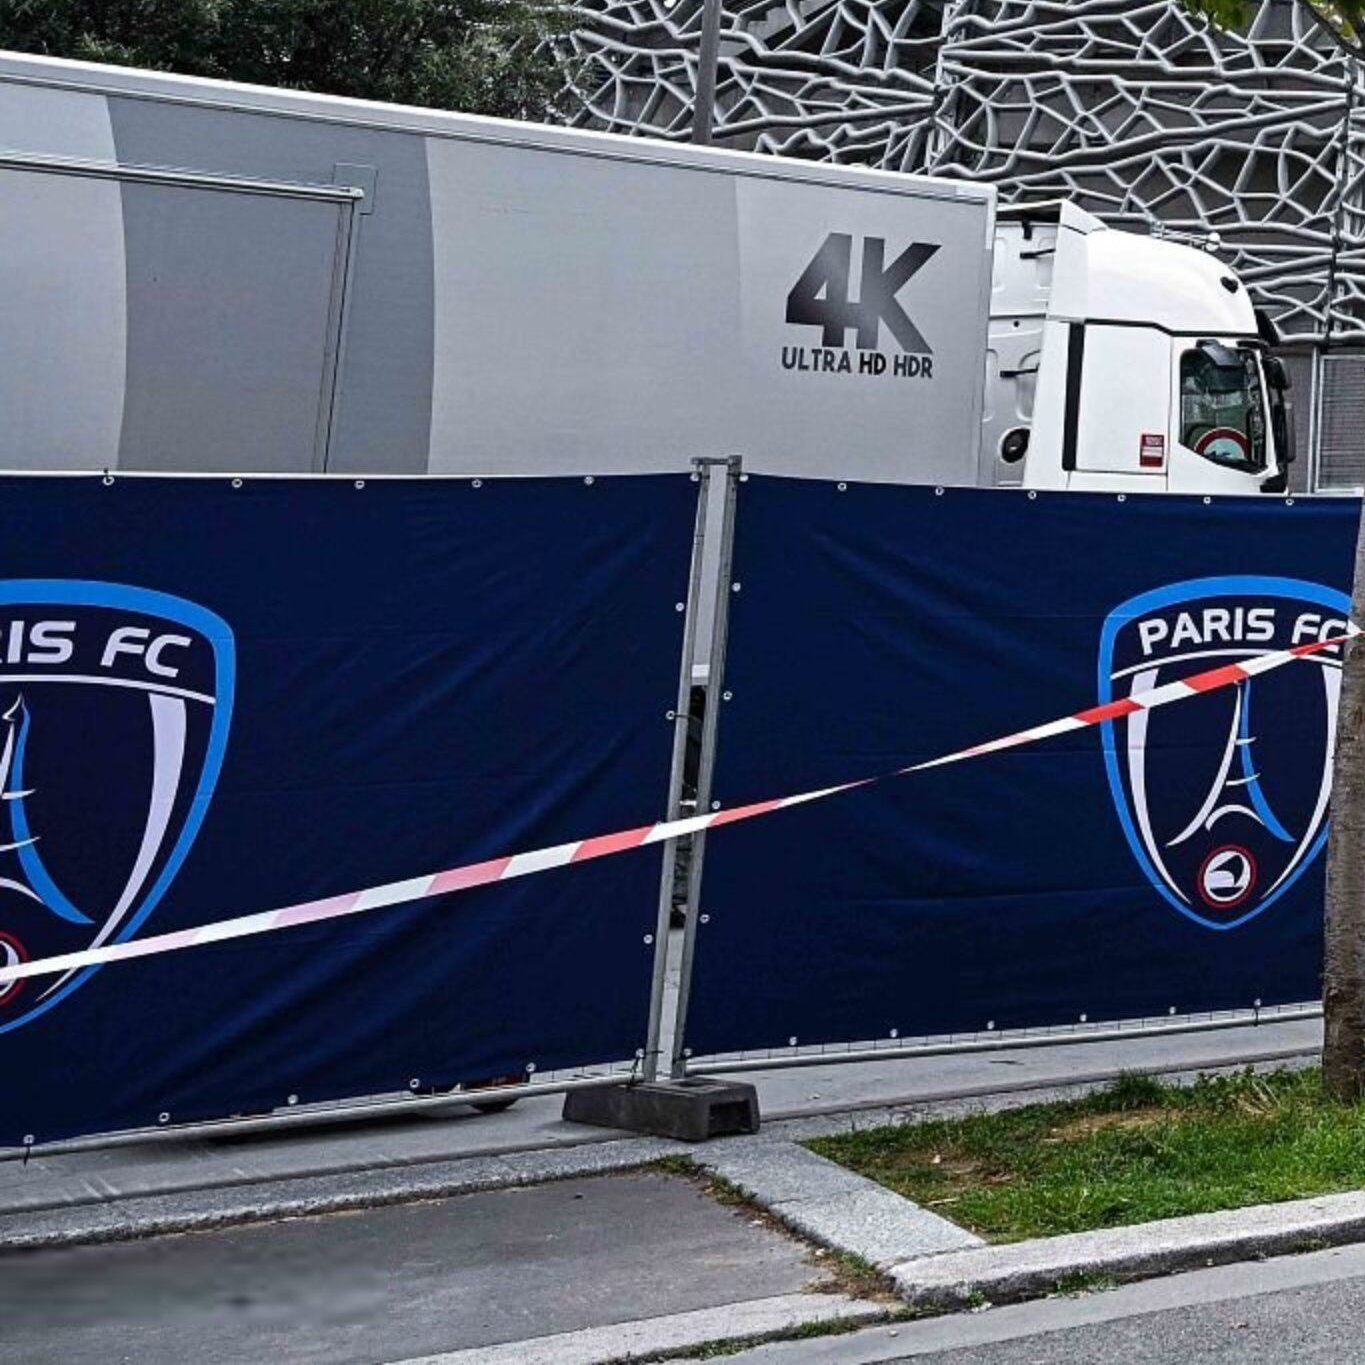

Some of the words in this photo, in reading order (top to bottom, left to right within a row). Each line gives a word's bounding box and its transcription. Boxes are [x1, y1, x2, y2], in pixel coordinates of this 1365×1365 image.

[785, 232, 942, 354] 4K
[781, 346, 851, 373] ULTRA
[859, 352, 887, 375] HD
[893, 355, 934, 379] HDR
[0, 620, 76, 664] IS
[100, 626, 192, 678] FC
[1138, 607, 1276, 656] PARIS
[1291, 613, 1347, 653] FC
